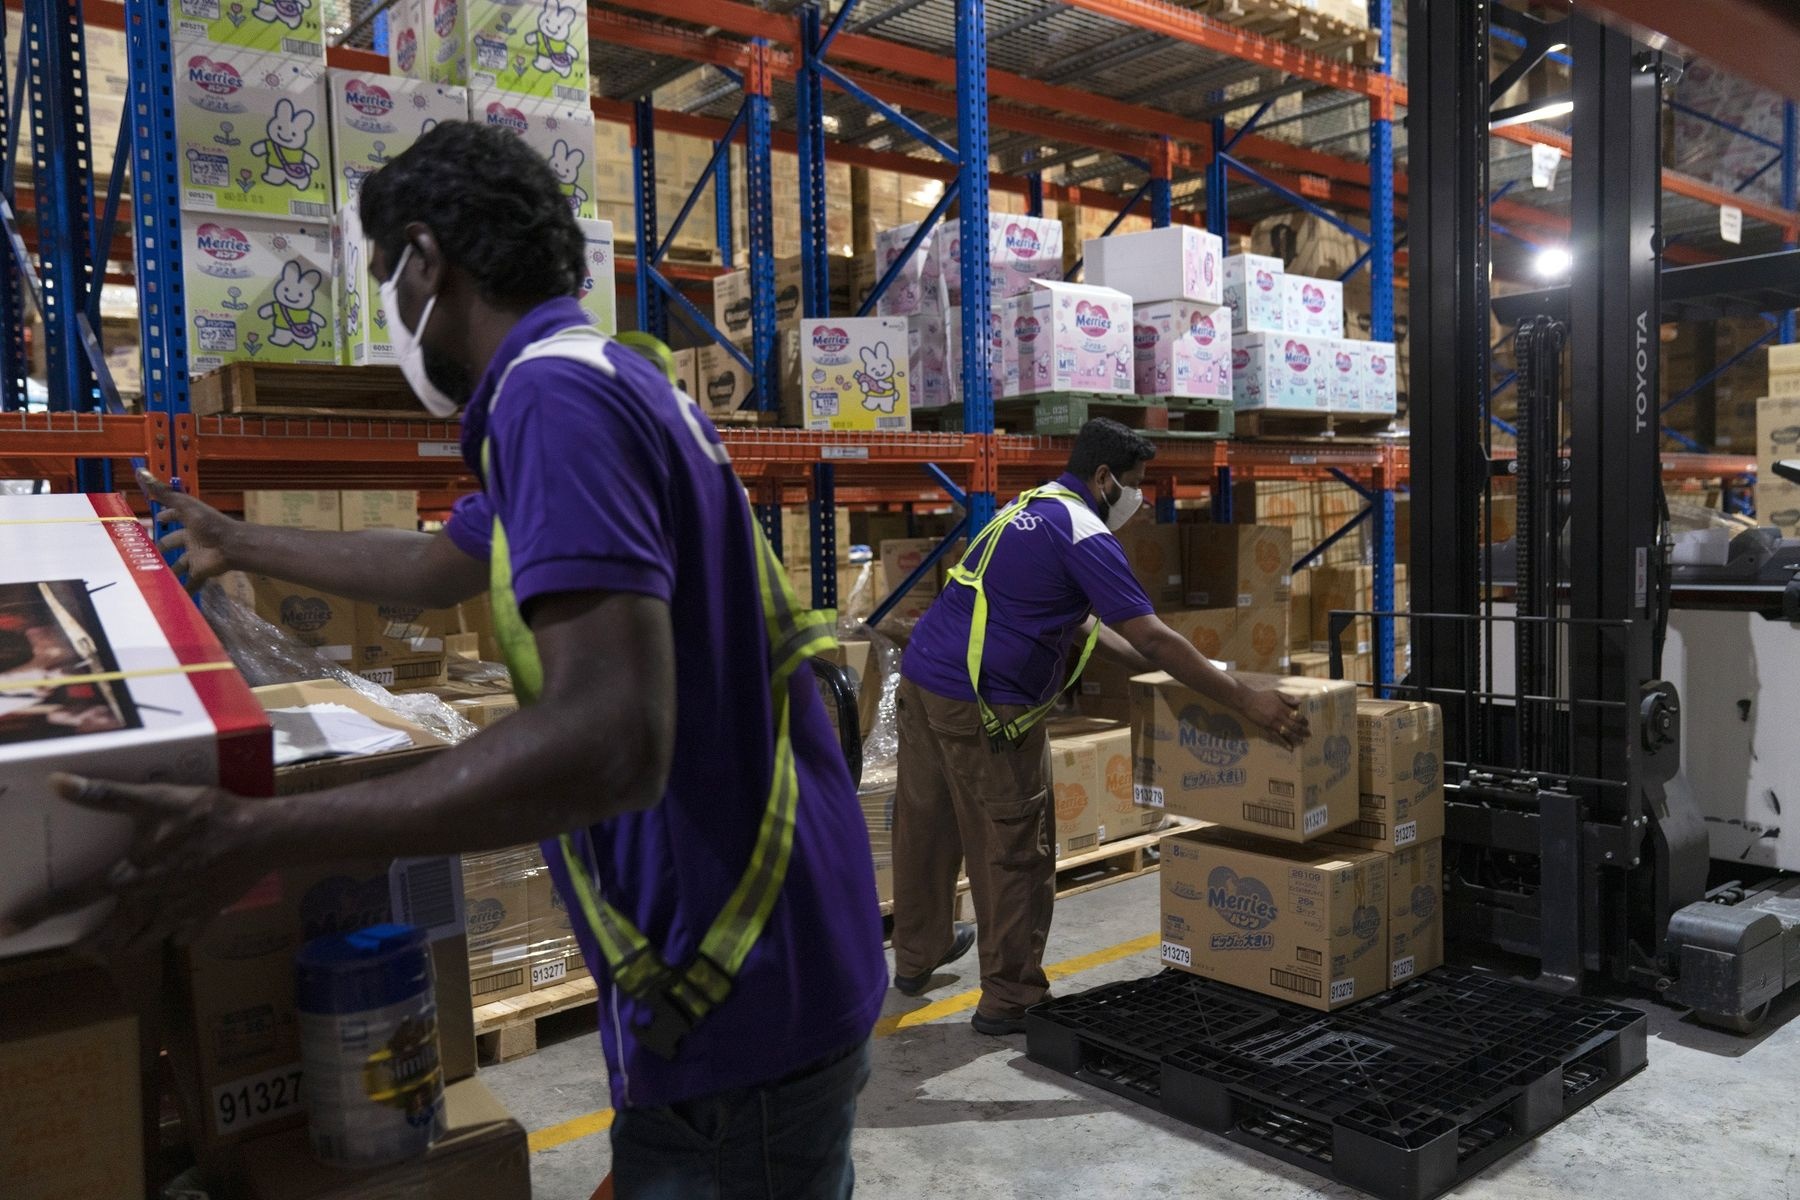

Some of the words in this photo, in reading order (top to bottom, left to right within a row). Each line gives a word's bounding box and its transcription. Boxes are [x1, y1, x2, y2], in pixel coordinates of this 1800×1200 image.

[189, 68, 243, 88] Merries
[345, 92, 394, 109] Merries
[487, 114, 529, 130] Merries
[198, 236, 251, 253] Merries
[1006, 236, 1041, 250] Merries
[1075, 315, 1112, 329] Merries
[1015, 325, 1041, 338] Merries
[1190, 325, 1216, 339] Merries
[812, 335, 850, 346] Merries
[1285, 352, 1312, 366] Merries
[1636, 310, 1648, 434] TOYOTA
[282, 607, 333, 624] Merries
[1179, 727, 1249, 754] Merries
[1135, 787, 1163, 804] 913279
[1395, 824, 1416, 843] 913279
[1208, 887, 1278, 920] Merries
[468, 909, 506, 925] erries
[1162, 944, 1190, 964] 913279
[533, 963, 565, 983] 913277
[1331, 982, 1353, 1001] 913279
[220, 1070, 304, 1124] 91327
